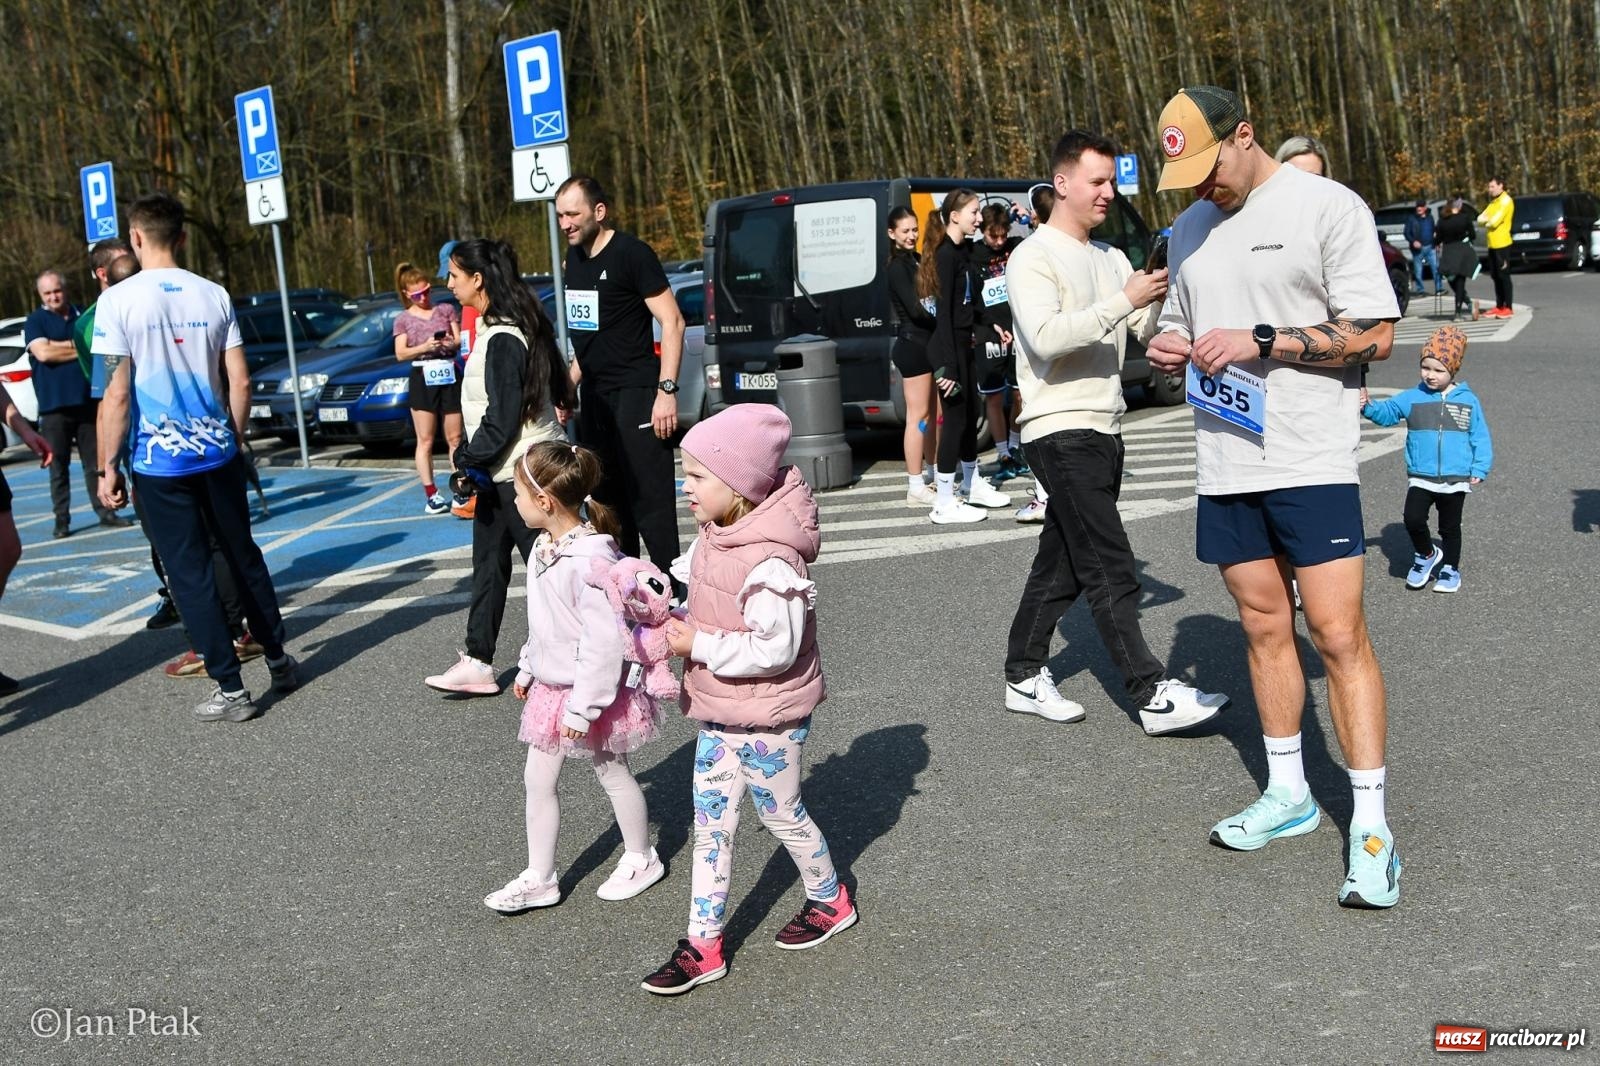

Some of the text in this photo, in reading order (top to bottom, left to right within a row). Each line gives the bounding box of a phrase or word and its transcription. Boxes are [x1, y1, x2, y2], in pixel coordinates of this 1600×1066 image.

[516, 45, 551, 116] P
[243, 97, 268, 155] P
[1120, 157, 1133, 177] P
[86, 171, 107, 220] P
[571, 304, 590, 319] 053
[721, 325, 752, 333] RENAULT
[854, 317, 883, 328] Trafic
[430, 368, 451, 379] 049
[1200, 375, 1250, 413] 055
